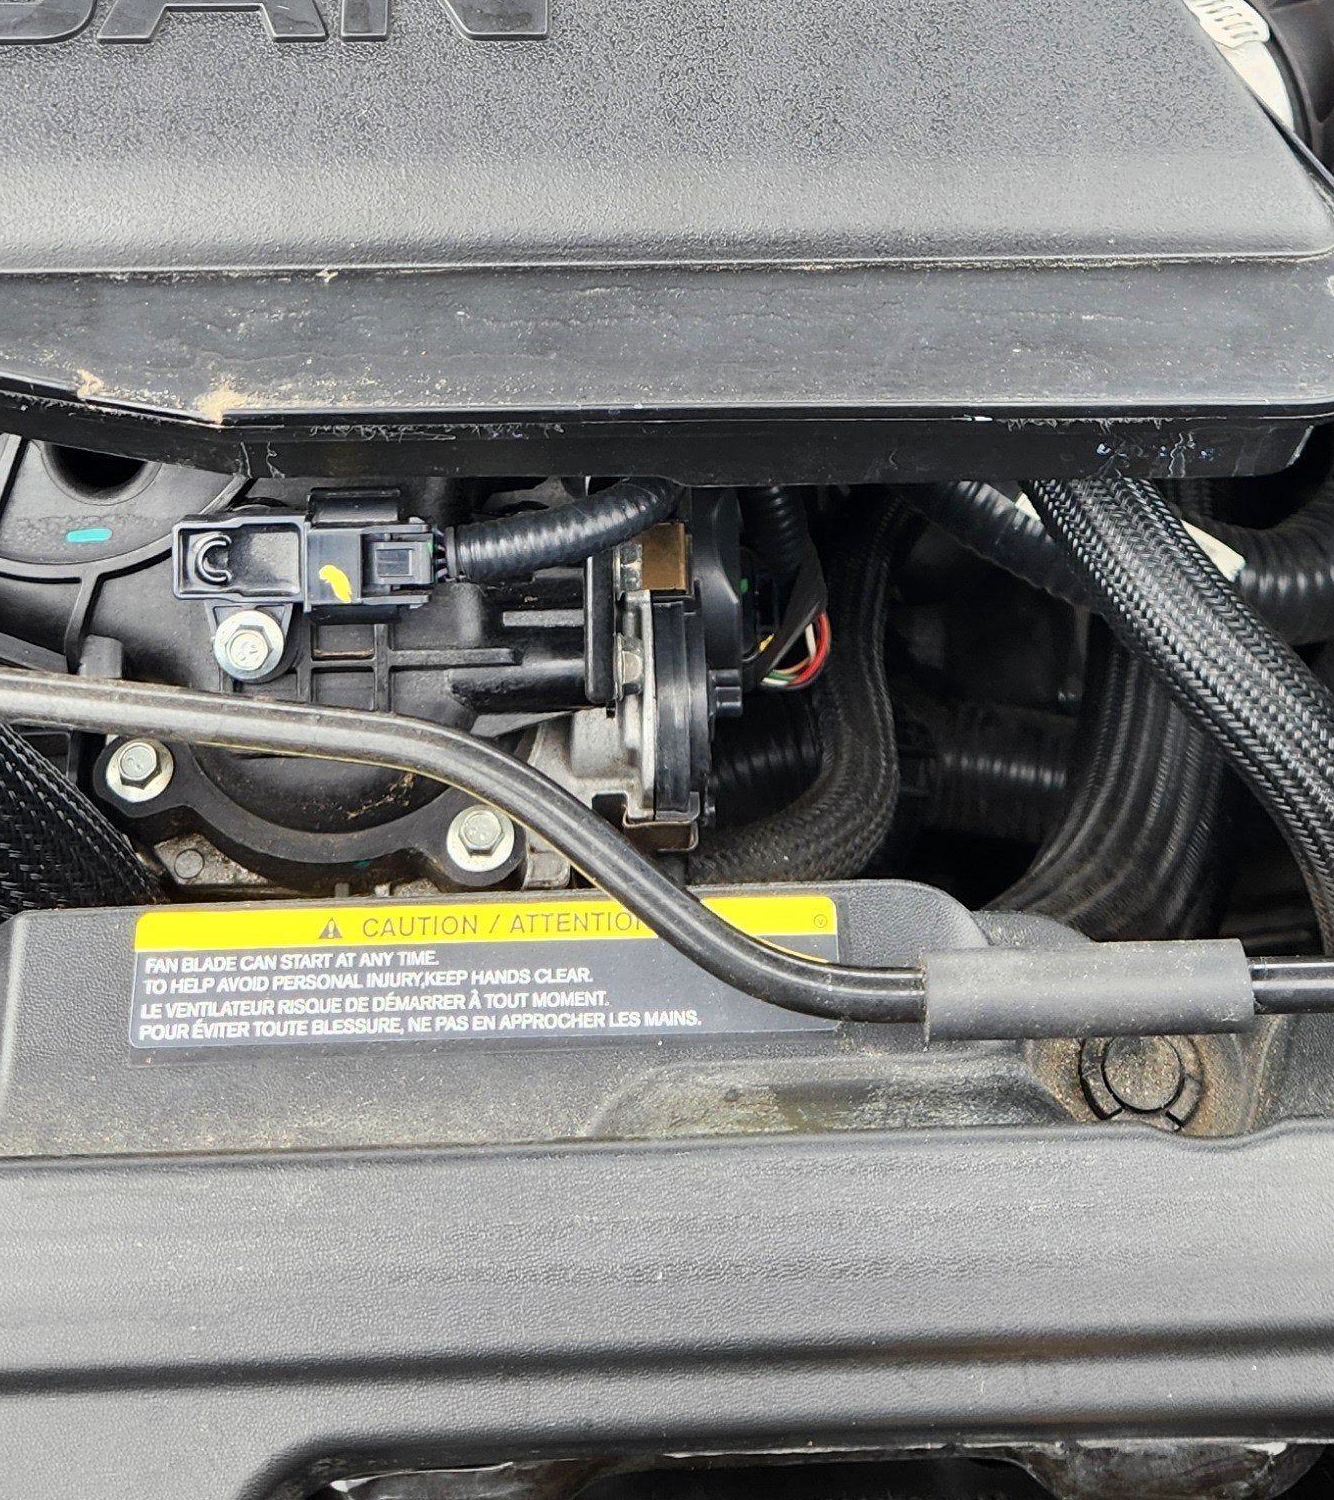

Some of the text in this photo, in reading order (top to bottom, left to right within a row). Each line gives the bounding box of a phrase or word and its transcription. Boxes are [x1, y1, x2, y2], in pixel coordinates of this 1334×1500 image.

[362, 914, 478, 938] CAUTION
[145, 950, 440, 974] FAN BLADE CAN START AT ANY TIME.
[143, 979, 167, 995] TO
[170, 977, 215, 994] HELP
[217, 976, 269, 992] AVOID
[272, 973, 364, 991] PERSONAL
[471, 969, 532, 985] HANDS
[534, 967, 594, 984] CLEAR.
[140, 989, 610, 1019] LE VENTILATEUR RISQUE DE DÉMARRER À TOUT MOMENT.
[139, 1009, 702, 1041] POUR ÉVITER TOUTE BLESSURE, NE PAS EN APPROCHER LES MAINS.
